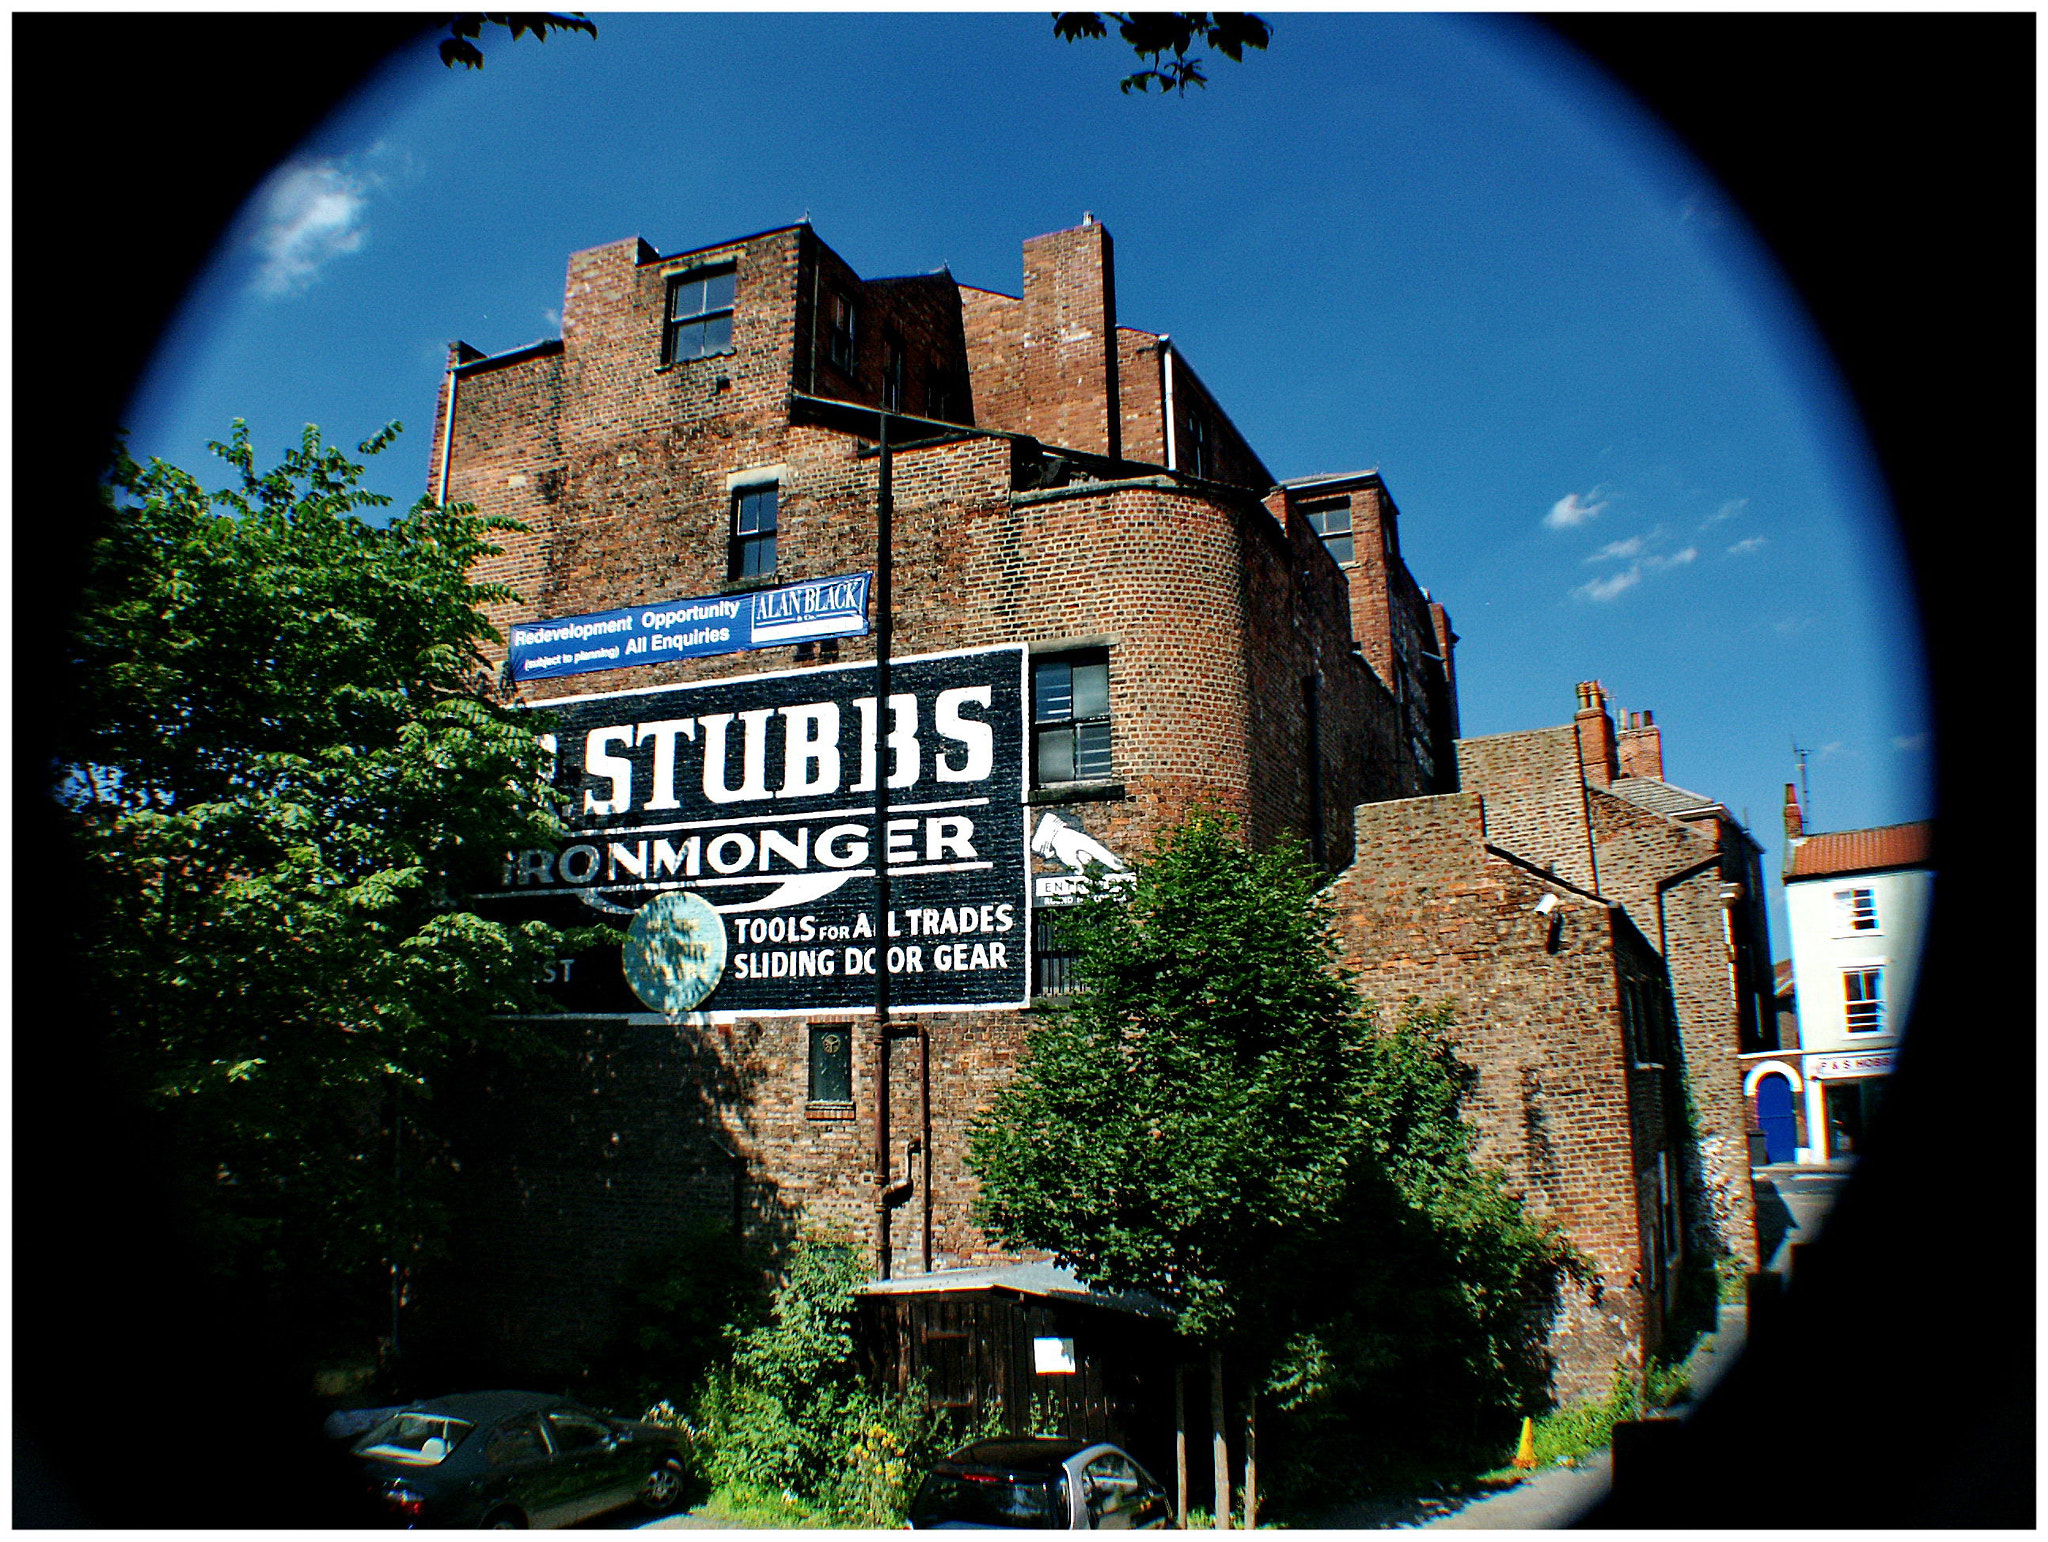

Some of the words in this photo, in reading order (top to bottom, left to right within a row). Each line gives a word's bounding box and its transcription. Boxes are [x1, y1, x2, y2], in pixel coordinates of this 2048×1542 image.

[756, 590, 802, 620] ALAN
[804, 581, 859, 614] BLACK
[515, 615, 633, 647] Redevelopment
[641, 600, 740, 631] Opportunity
[625, 636, 648, 655] All
[651, 627, 731, 652] Enquiries
[524, 655, 562, 671] (subject
[562, 654, 573, 664] to
[573, 646, 620, 664] planning)
[583, 685, 993, 816] STUBBS
[501, 815, 978, 886] IRONMONGER
[734, 915, 816, 944] TOOLS
[819, 925, 850, 940] FOR
[852, 910, 901, 938] AL
[905, 903, 1014, 936] TRADES
[733, 949, 835, 980] SLIDING
[844, 946, 924, 976] DOOR
[933, 941, 1009, 972] GEAR
